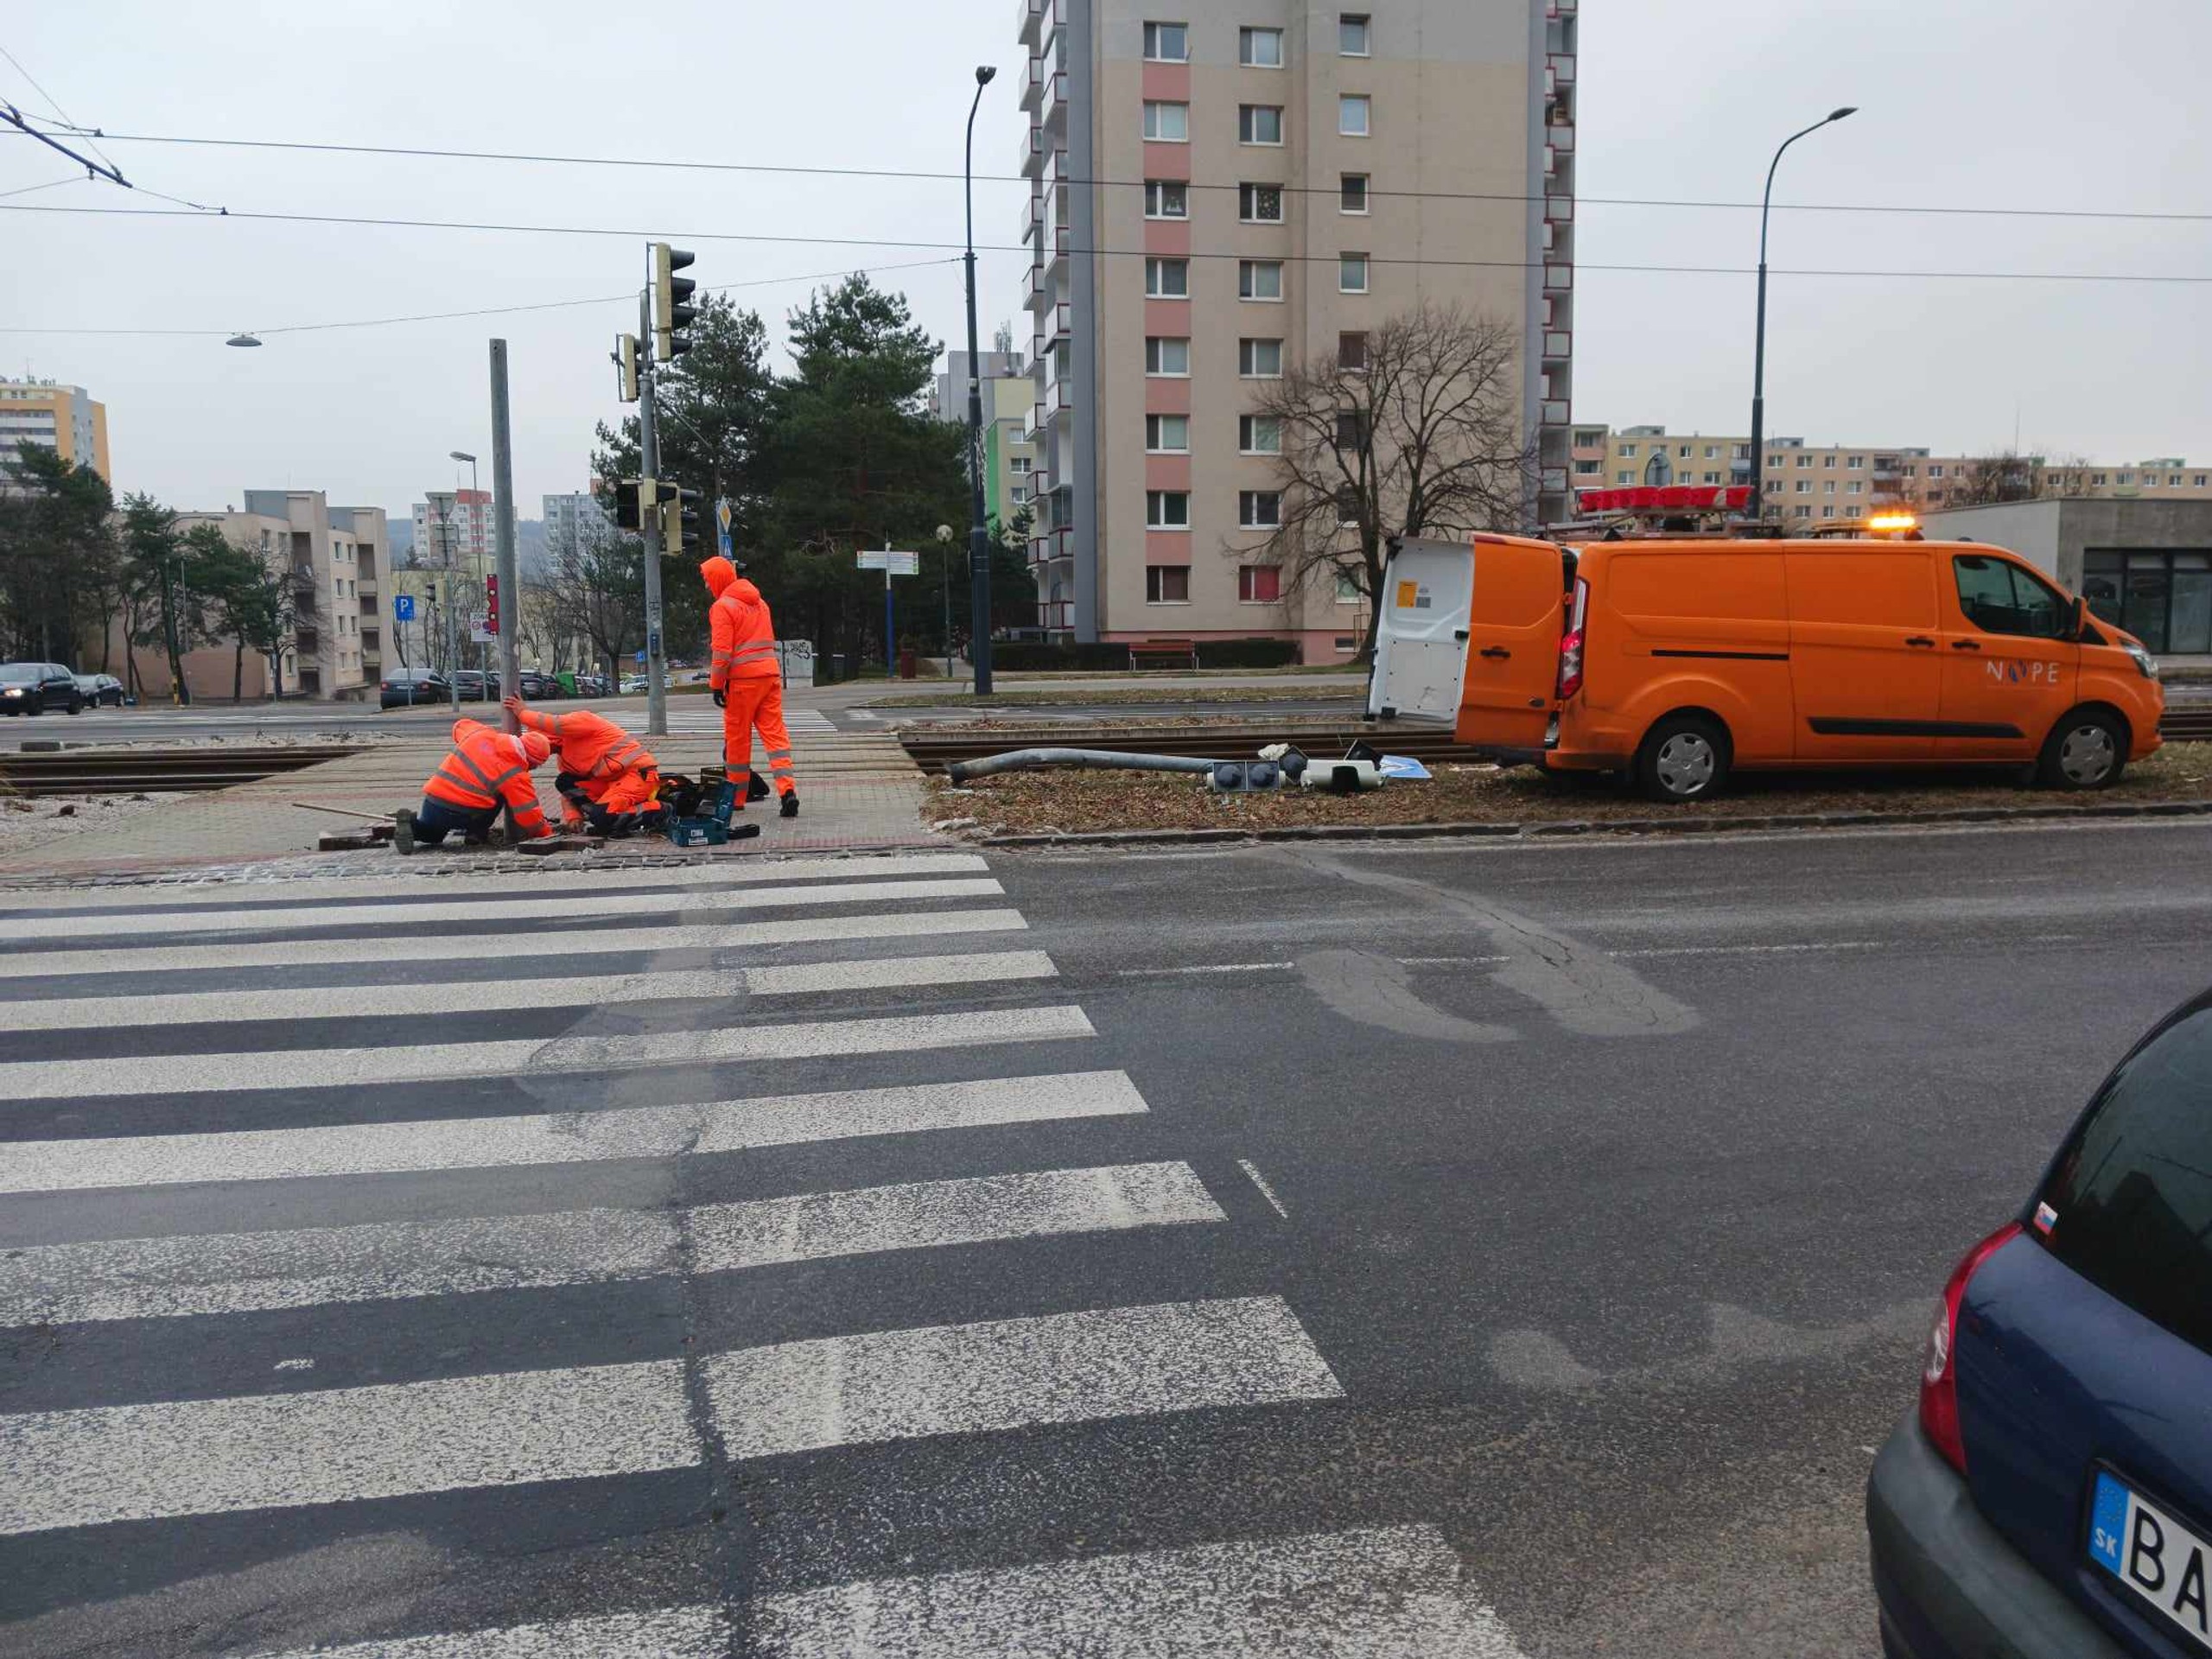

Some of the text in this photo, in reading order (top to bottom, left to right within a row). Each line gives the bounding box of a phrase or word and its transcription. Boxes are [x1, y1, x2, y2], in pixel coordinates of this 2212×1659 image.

[400, 598, 409, 613] P
[2094, 1527, 2117, 1558] SK
[2129, 1506, 2208, 1635] BA
